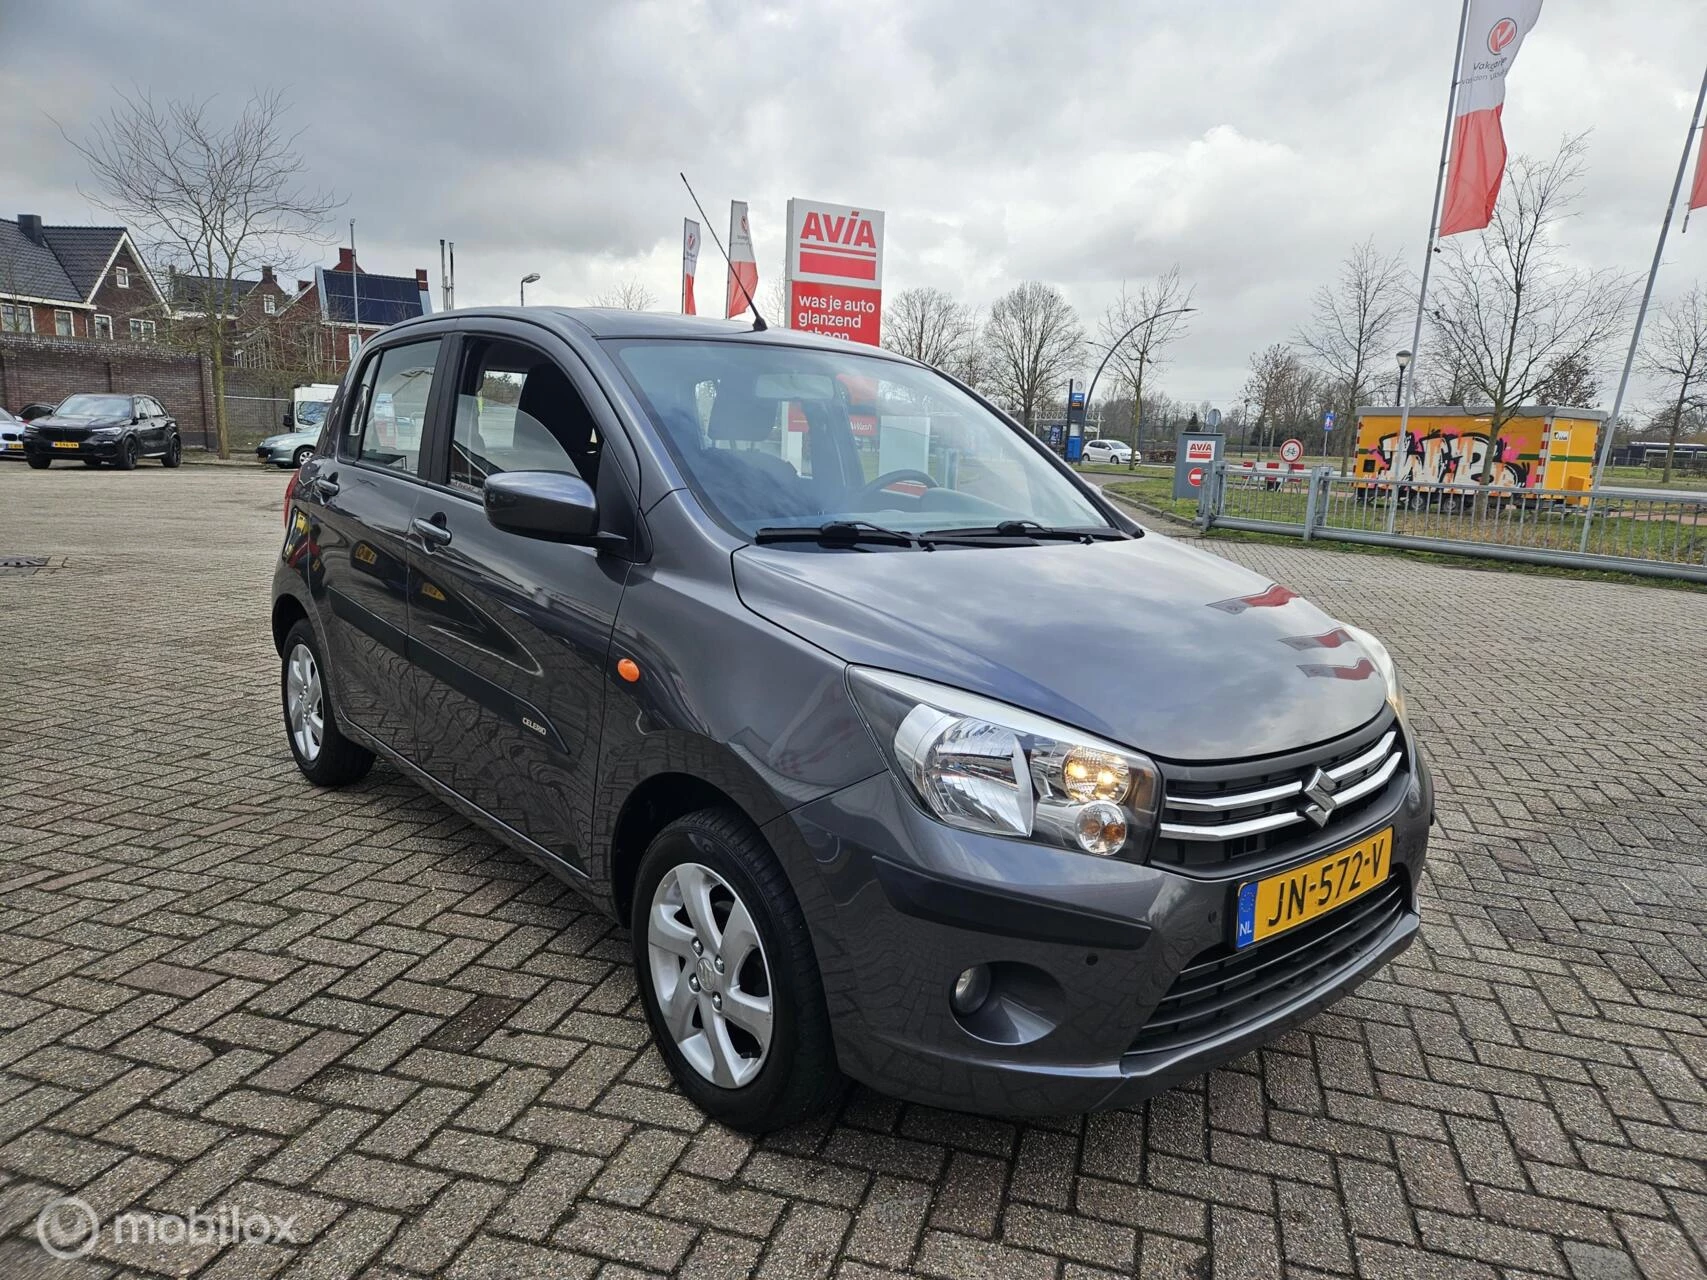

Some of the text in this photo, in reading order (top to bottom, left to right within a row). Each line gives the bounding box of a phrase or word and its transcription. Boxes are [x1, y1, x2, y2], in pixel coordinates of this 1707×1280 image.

[800, 211, 876, 248] AVIA
[798, 295, 875, 313] was je auto
[798, 310, 862, 329] glanzend
[1190, 442, 1213, 451] AVIA
[1267, 838, 1385, 928] JN-572-V
[1239, 920, 1253, 937] NL
